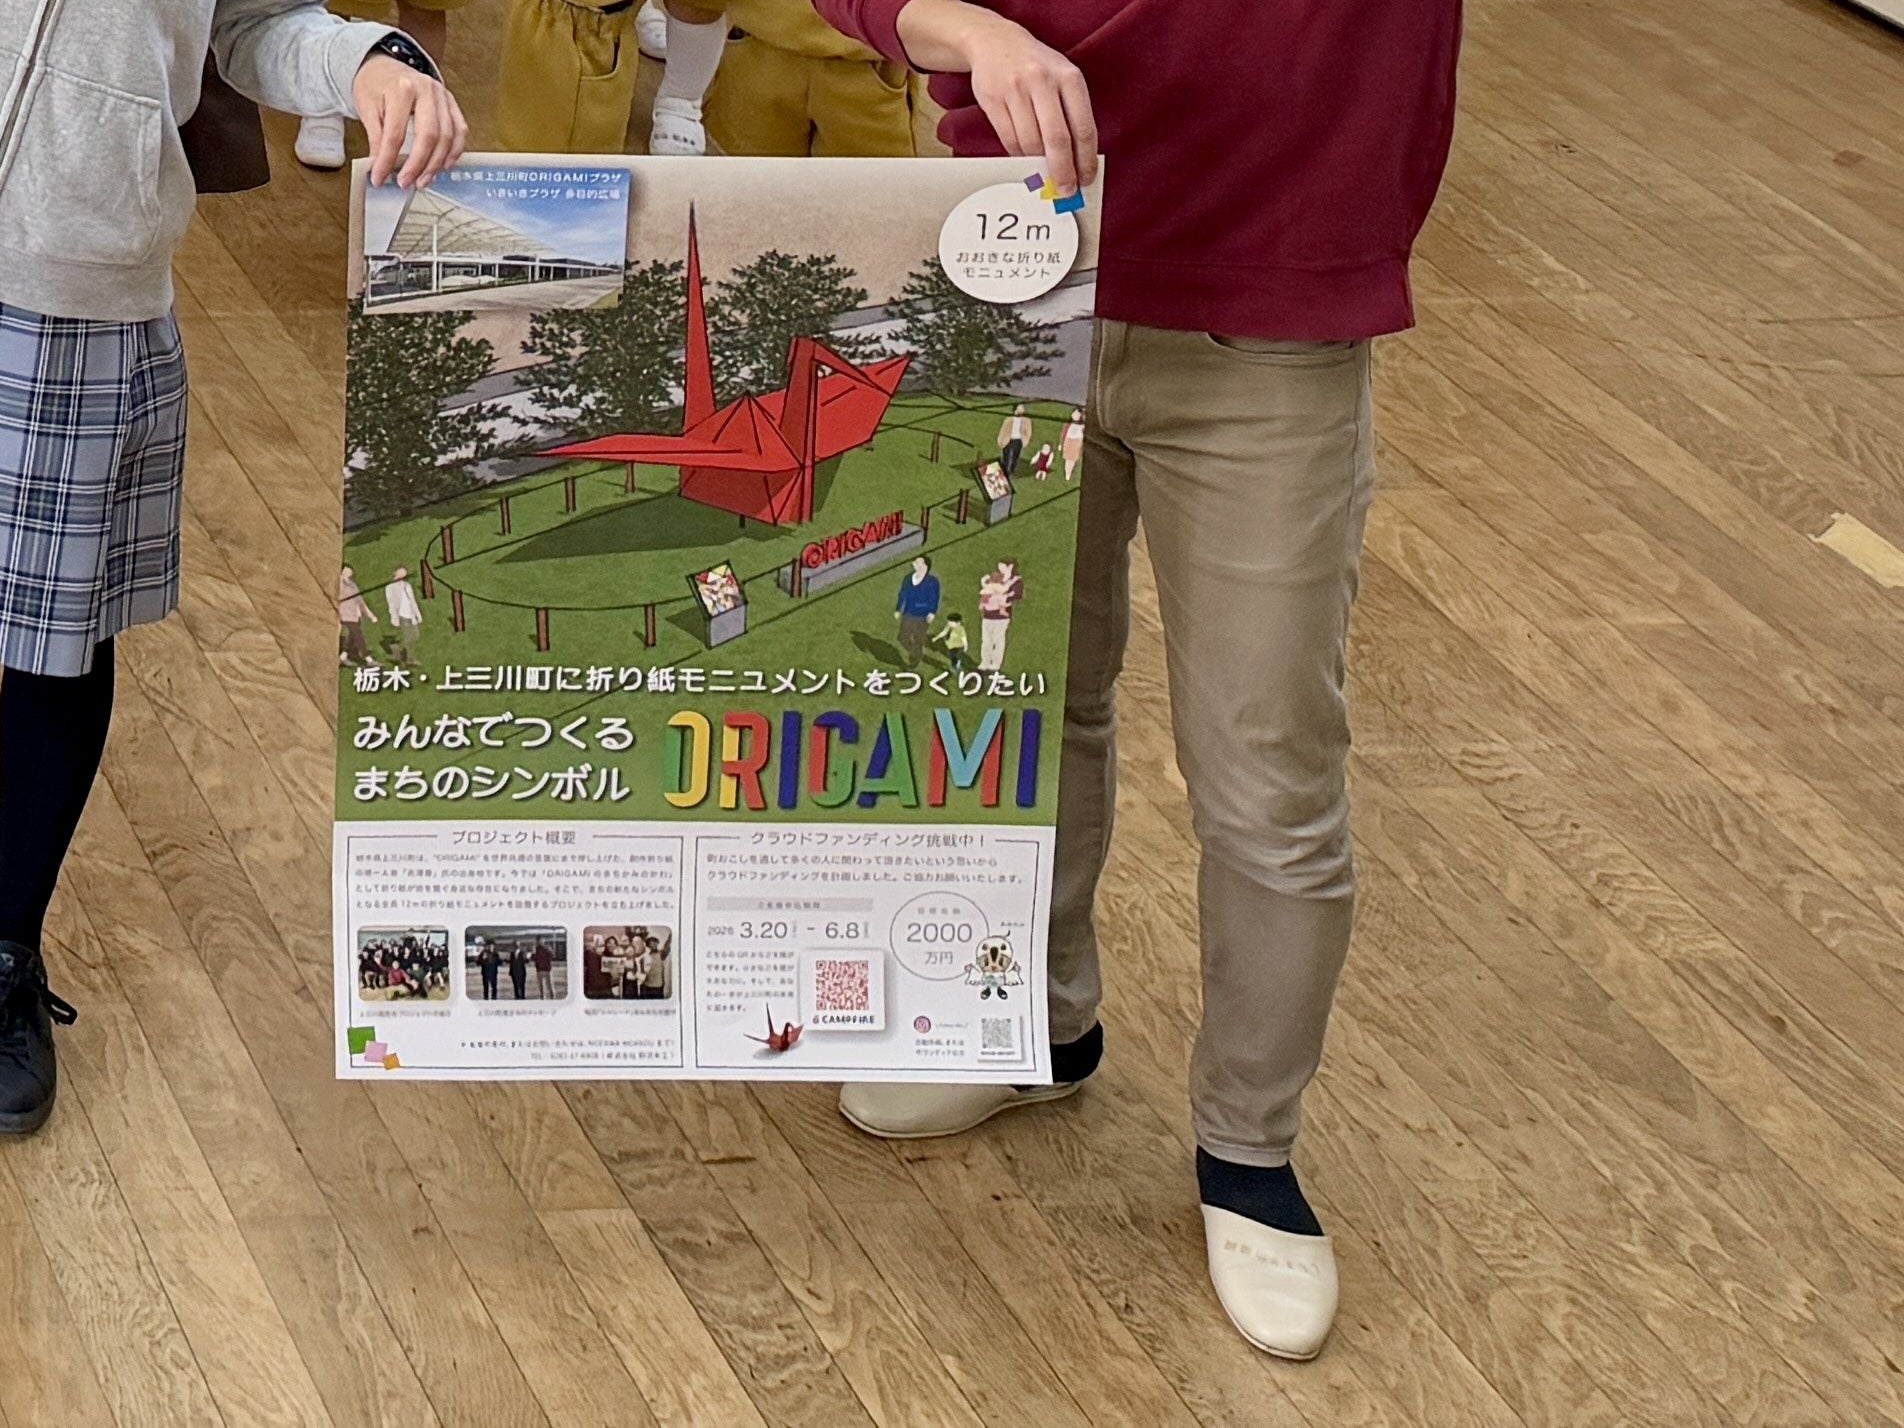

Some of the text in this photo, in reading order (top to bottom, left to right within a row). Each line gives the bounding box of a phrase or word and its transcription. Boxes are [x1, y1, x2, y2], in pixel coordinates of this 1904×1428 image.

[976, 213, 1050, 240] 12m
[956, 252, 1061, 264] おおきな折り紙
[963, 267, 1051, 279] モニュメント
[353, 711, 634, 750] みんなでつくる
[663, 707, 1042, 810] ORIGAMI
[353, 762, 630, 800] まちのシンボル
[451, 830, 577, 845] プロジェクト概要
[739, 921, 788, 939] 3.20
[825, 921, 860, 939] 6.8
[906, 922, 973, 944] 2000
[924, 951, 954, 966] 万円
